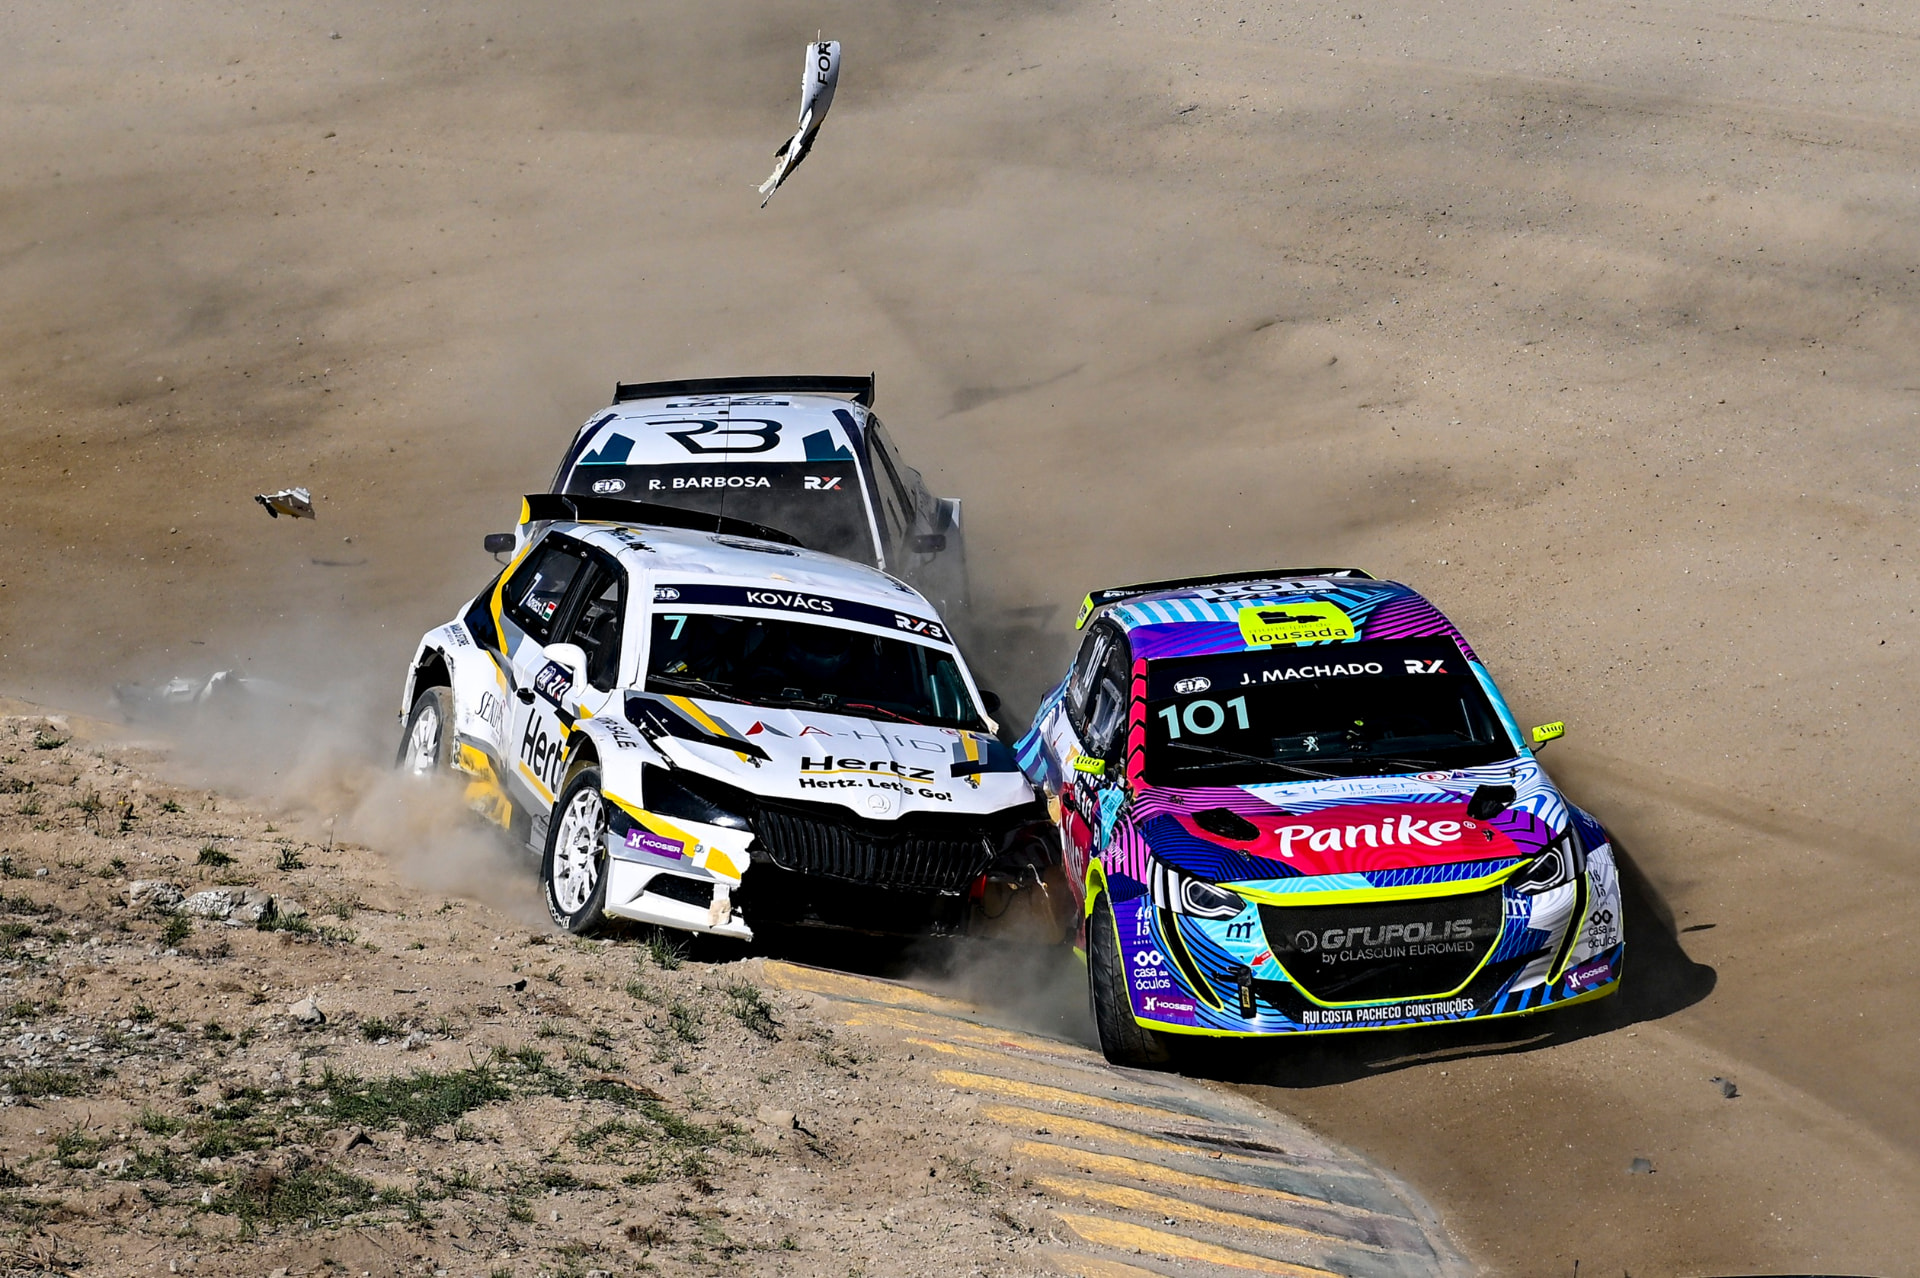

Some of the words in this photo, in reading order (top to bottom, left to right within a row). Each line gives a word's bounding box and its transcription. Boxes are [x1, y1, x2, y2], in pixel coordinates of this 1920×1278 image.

[593, 479, 625, 493] FIA
[648, 478, 666, 490] R.
[672, 476, 771, 490] BARBOSA
[747, 591, 834, 612] KOVÁCS
[663, 615, 688, 640] 7
[1251, 627, 1348, 643] lousada
[1240, 672, 1256, 685] J.
[1263, 662, 1383, 682] MACHADO
[1176, 678, 1210, 693] FIA
[1158, 696, 1250, 739] 101
[606, 725, 637, 748] SALE
[801, 756, 934, 781] Hertz
[799, 778, 863, 789] Hertz.
[867, 778, 914, 795] Let's
[918, 788, 953, 802] Go!
[642, 838, 681, 854] HOOSIER
[1135, 906, 1153, 920] 46
[1136, 921, 1150, 936] 15
[1588, 926, 1608, 937] casa
[1322, 952, 1337, 965] by
[1340, 947, 1406, 962] CLASQUIN
[1409, 940, 1475, 956] EUROMED
[1134, 967, 1157, 978] casa
[1578, 964, 1609, 980] HOOSIER
[1135, 977, 1171, 990] óculos
[1156, 1001, 1194, 1012] HOOSIER
[1302, 1010, 1320, 1024] RUI
[1321, 1009, 1353, 1023] COSTA
[1356, 1007, 1401, 1022] PACHECO
[1405, 998, 1475, 1017] CONSTRUÇÕES
